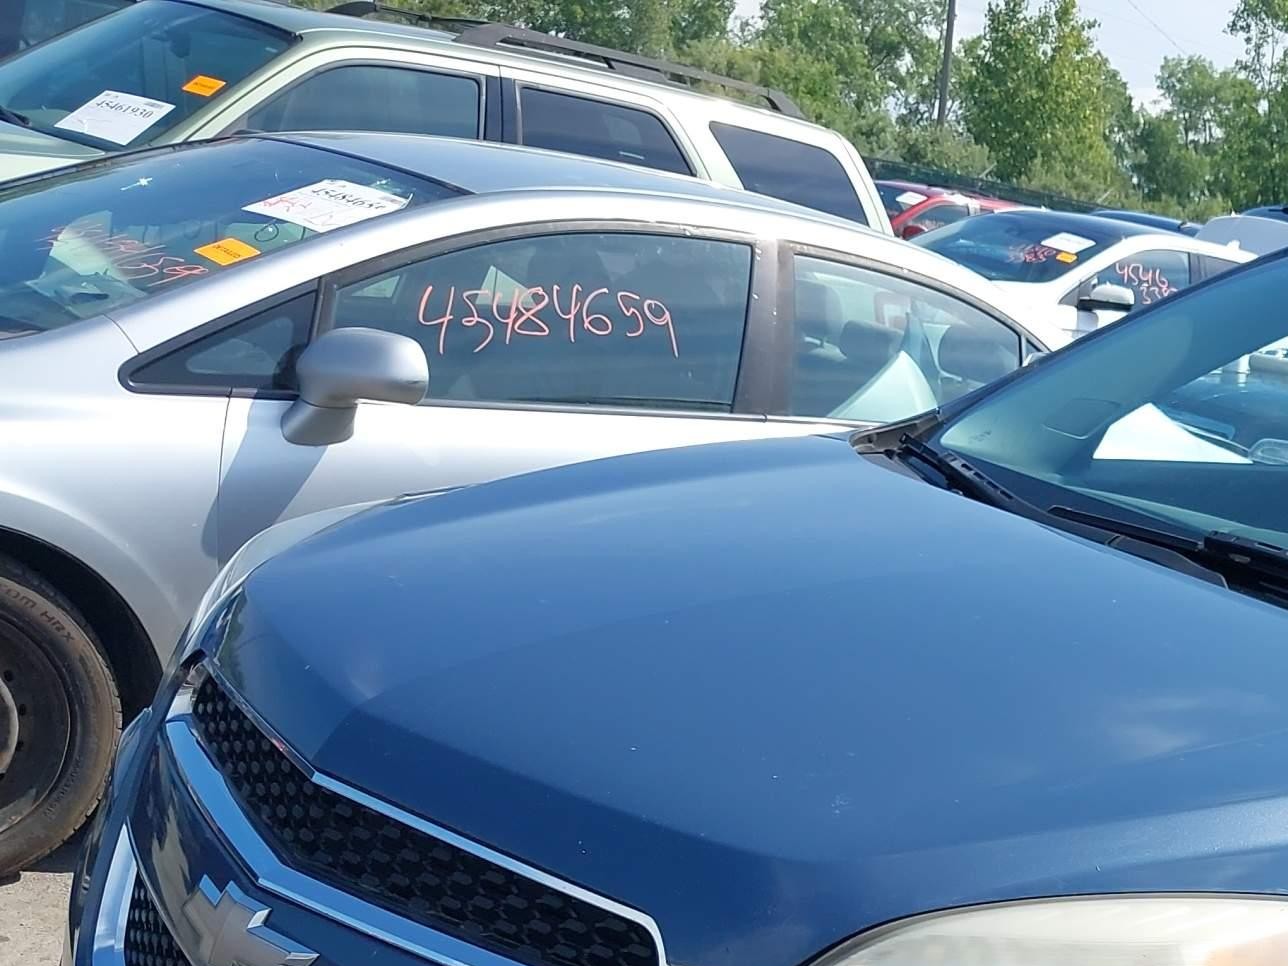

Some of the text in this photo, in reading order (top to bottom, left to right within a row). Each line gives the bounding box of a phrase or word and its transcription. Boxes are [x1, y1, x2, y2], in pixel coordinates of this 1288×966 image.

[95, 99, 154, 119] 45461930
[1115, 262, 1169, 288] 4546
[417, 284, 679, 359] 45484659
